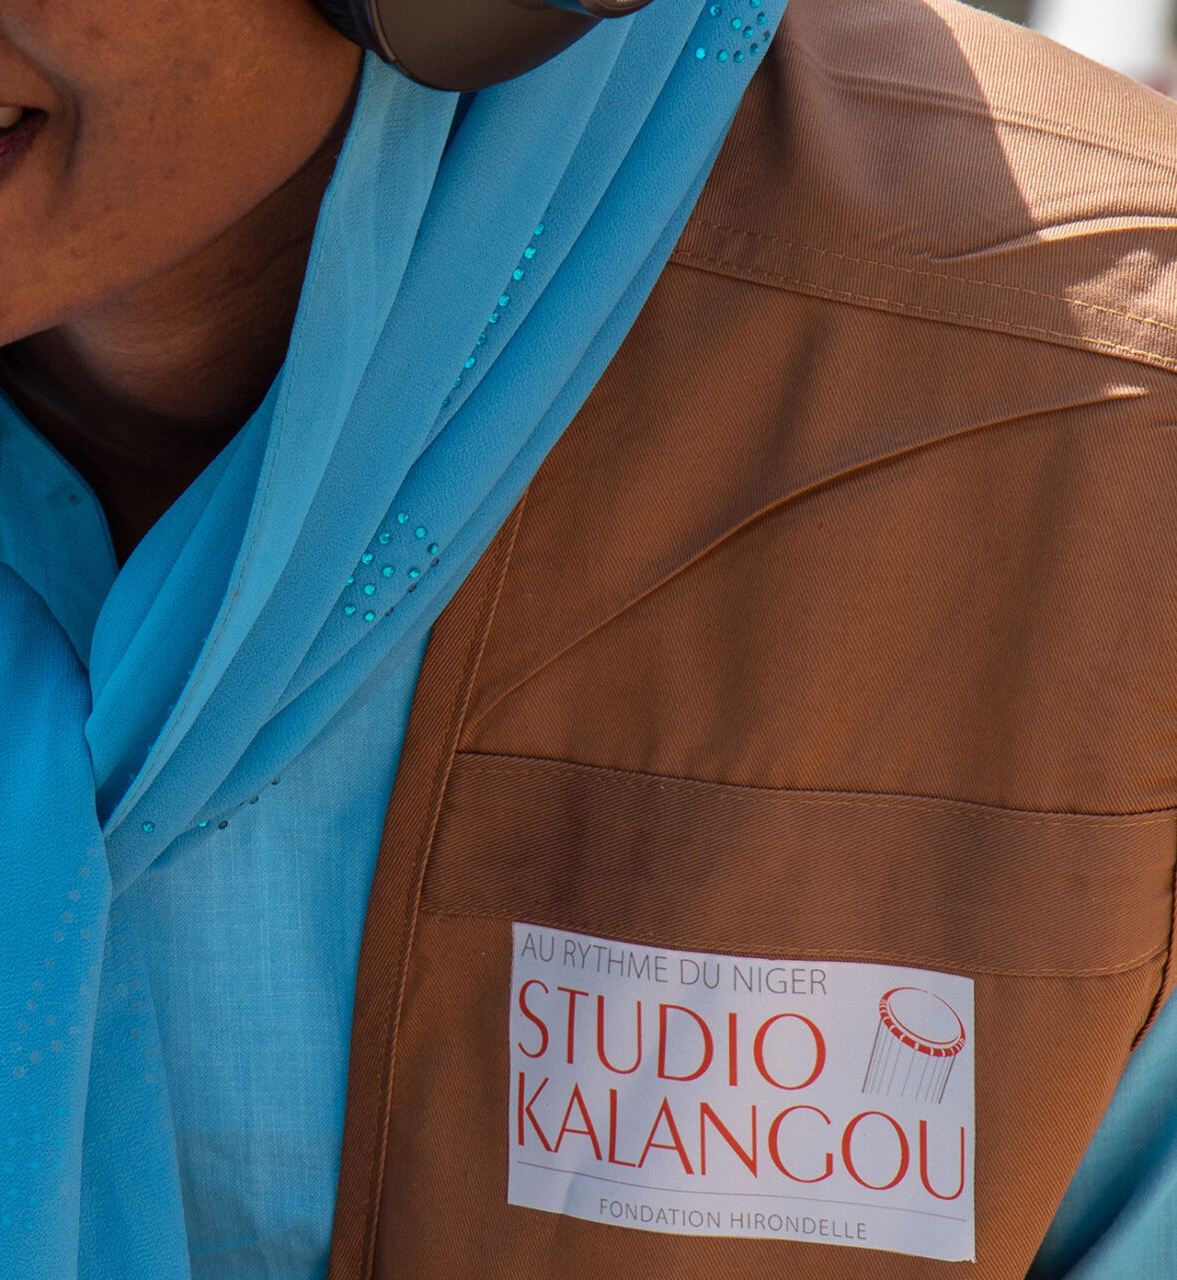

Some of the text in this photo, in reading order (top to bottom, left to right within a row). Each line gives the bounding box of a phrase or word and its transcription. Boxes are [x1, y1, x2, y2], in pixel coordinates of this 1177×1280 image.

[521, 931, 828, 996] AU RYTHME DU NIGER
[517, 978, 828, 1090] STUDIO
[517, 1071, 966, 1201] KALANGOU
[599, 1198, 868, 1241] FONDATION HIRONDELLE
